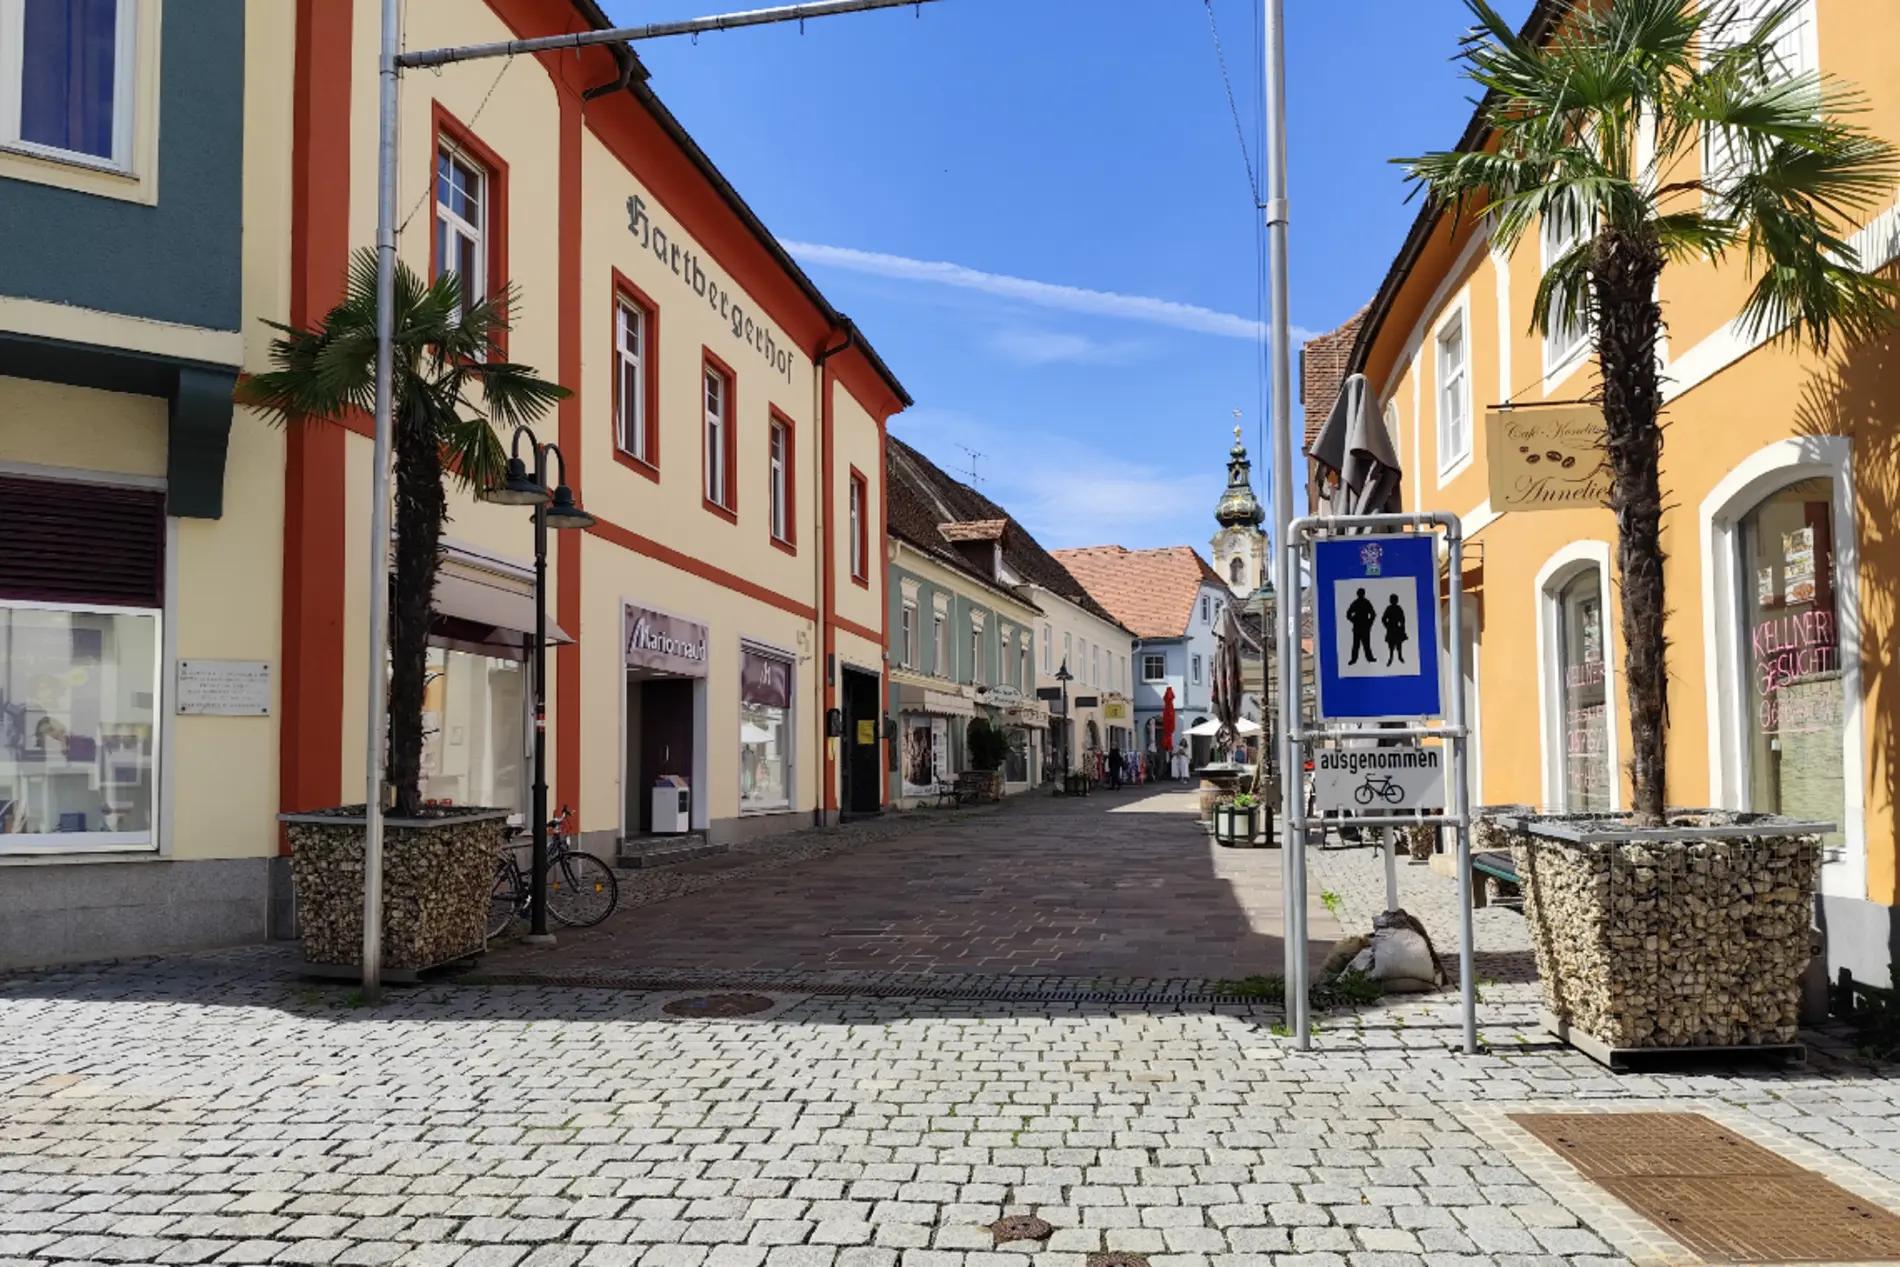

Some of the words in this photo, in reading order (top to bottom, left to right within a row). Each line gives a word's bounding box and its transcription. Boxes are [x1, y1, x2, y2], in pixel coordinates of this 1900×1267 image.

[625, 194, 794, 384] Hartbergerhof
[1546, 419, 1601, 440] Kondit
[1505, 474, 1609, 504] Annelie
[629, 616, 706, 661] Marionnaud
[1320, 750, 1438, 774] ausgenommen
